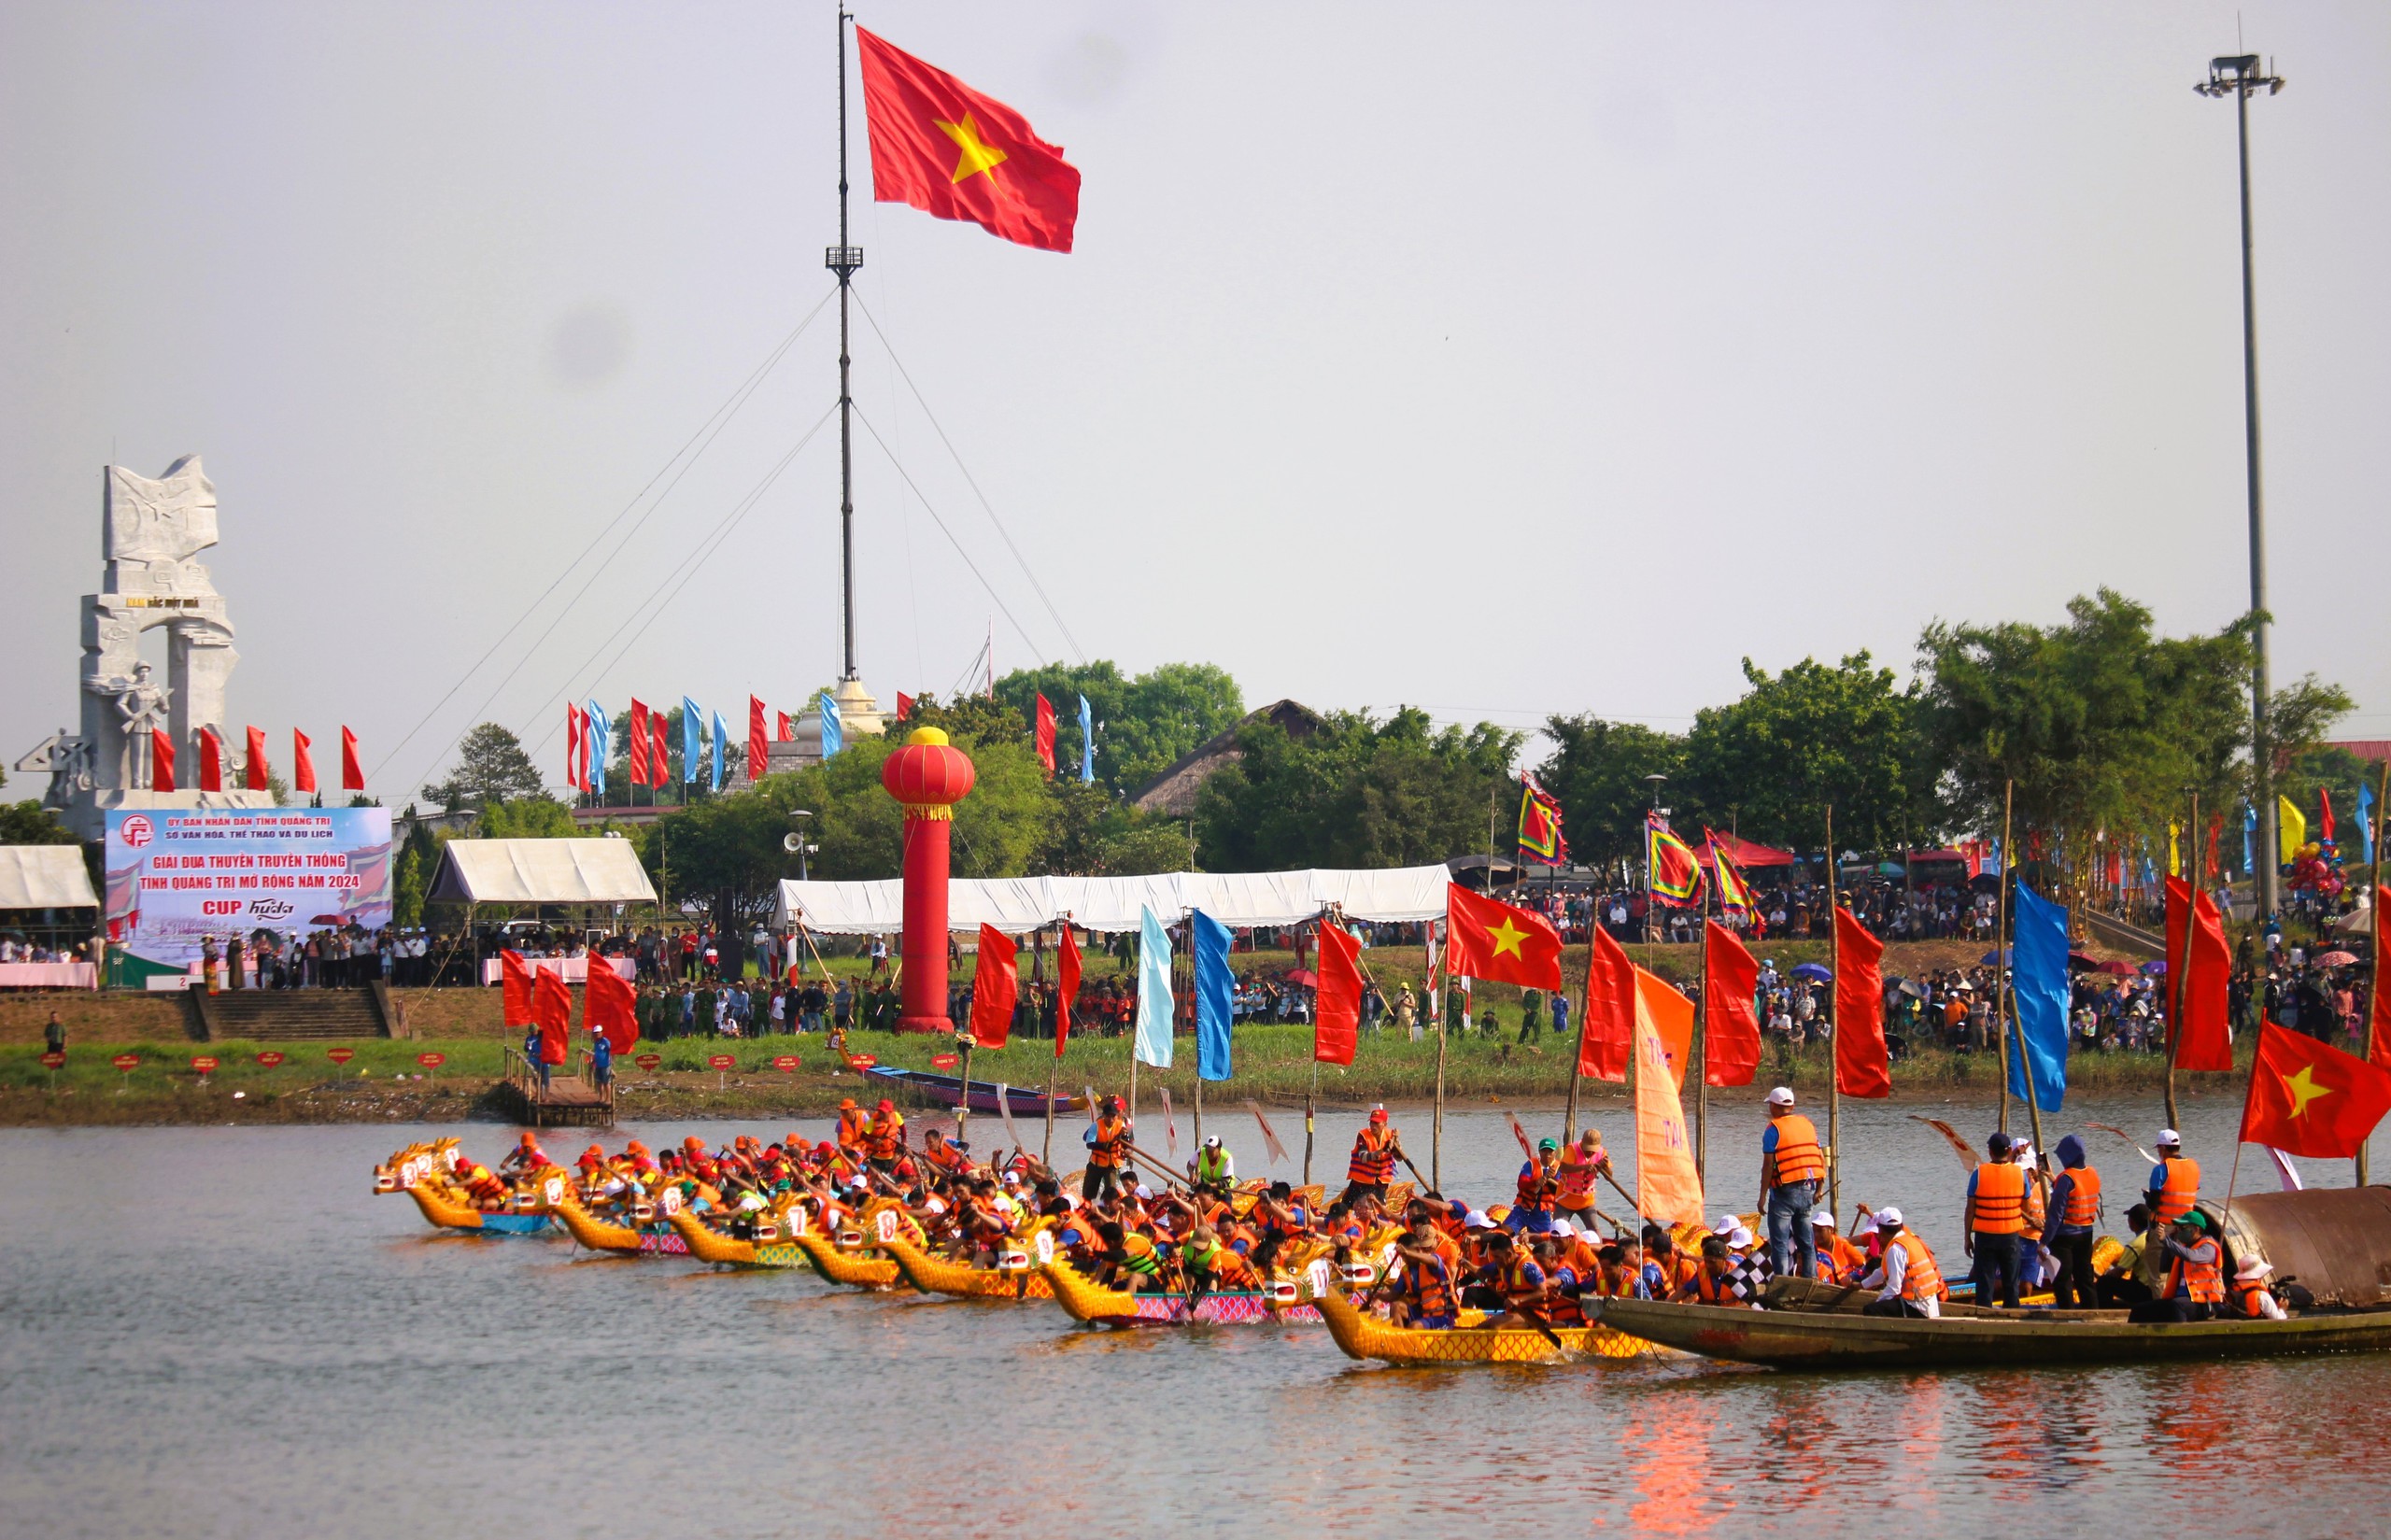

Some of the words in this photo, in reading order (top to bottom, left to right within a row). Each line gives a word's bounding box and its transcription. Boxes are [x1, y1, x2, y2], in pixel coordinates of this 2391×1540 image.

[183, 818, 202, 827] BAN
[205, 816, 230, 827] NHÂN
[233, 817, 252, 826] DÂN
[182, 830, 201, 839] VĂN
[153, 854, 177, 869] GIẢI
[181, 855, 205, 869] ĐUA
[208, 852, 253, 869] THUYỀN
[258, 851, 302, 868] TRUYỀN
[306, 851, 346, 868] THỐNG
[140, 875, 167, 890] TỈNH
[172, 874, 212, 890] QUẢNG
[216, 876, 235, 891] TRỊ
[239, 874, 258, 888] MỞ
[262, 874, 294, 890] RỘNG
[299, 873, 324, 888] NĂM
[329, 875, 359, 888] 2024
[203, 900, 242, 915] CUP
[248, 898, 294, 920] huda
[179, 977, 186, 986] 2
[790, 1209, 802, 1233] 7
[882, 1214, 894, 1239] 8
[1041, 1238, 1050, 1254] 9
[1314, 1269, 1328, 1288] 11
